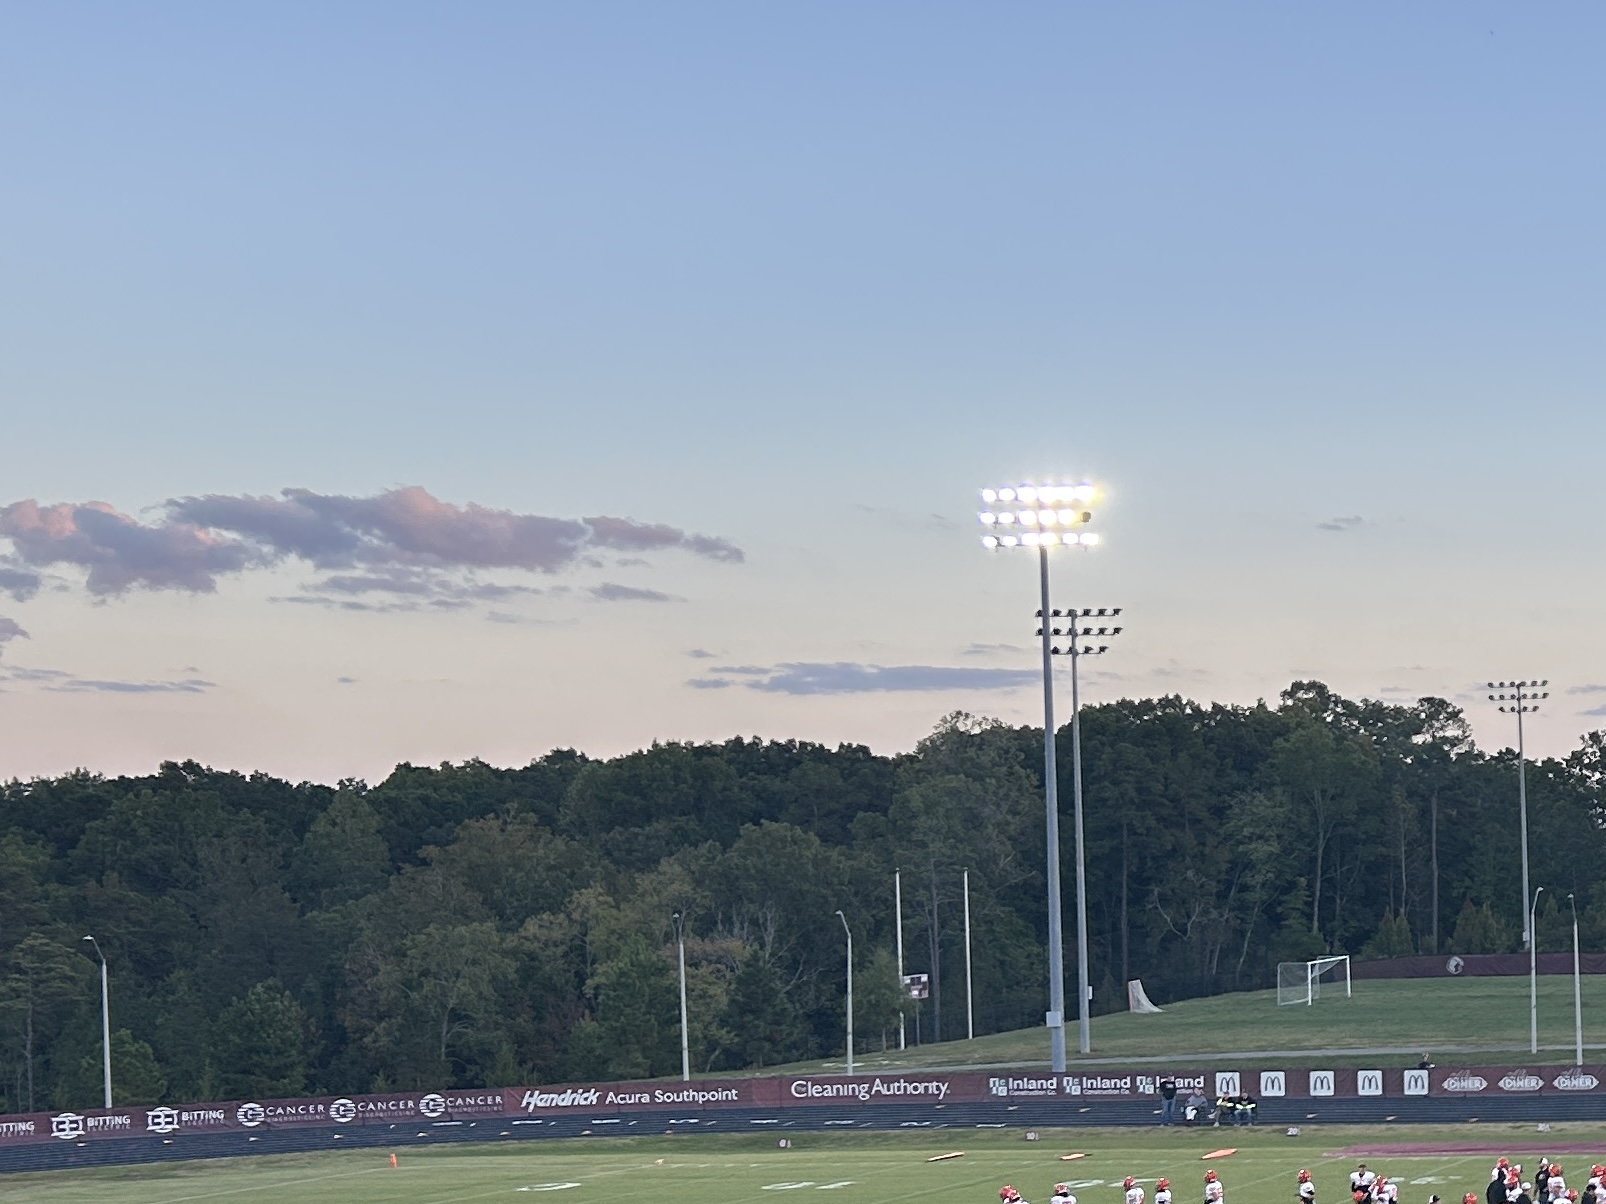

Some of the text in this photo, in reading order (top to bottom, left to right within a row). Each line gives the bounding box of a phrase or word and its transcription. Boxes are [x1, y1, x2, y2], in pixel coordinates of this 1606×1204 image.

[1008, 1077, 1057, 1090] Inland
[1082, 1076, 1131, 1089] Inland
[1155, 1075, 1205, 1088] Iand
[791, 1078, 948, 1100] Cleaning Authority
[446, 1096, 503, 1107] CANCER
[521, 1087, 738, 1112] Hendrick Acura Southpoint
[266, 1104, 325, 1116] CANCER
[358, 1100, 415, 1112] CANCER
[87, 1115, 131, 1127] BITTING
[182, 1109, 225, 1121] BITTING
[0, 1121, 35, 1133] ITTING
